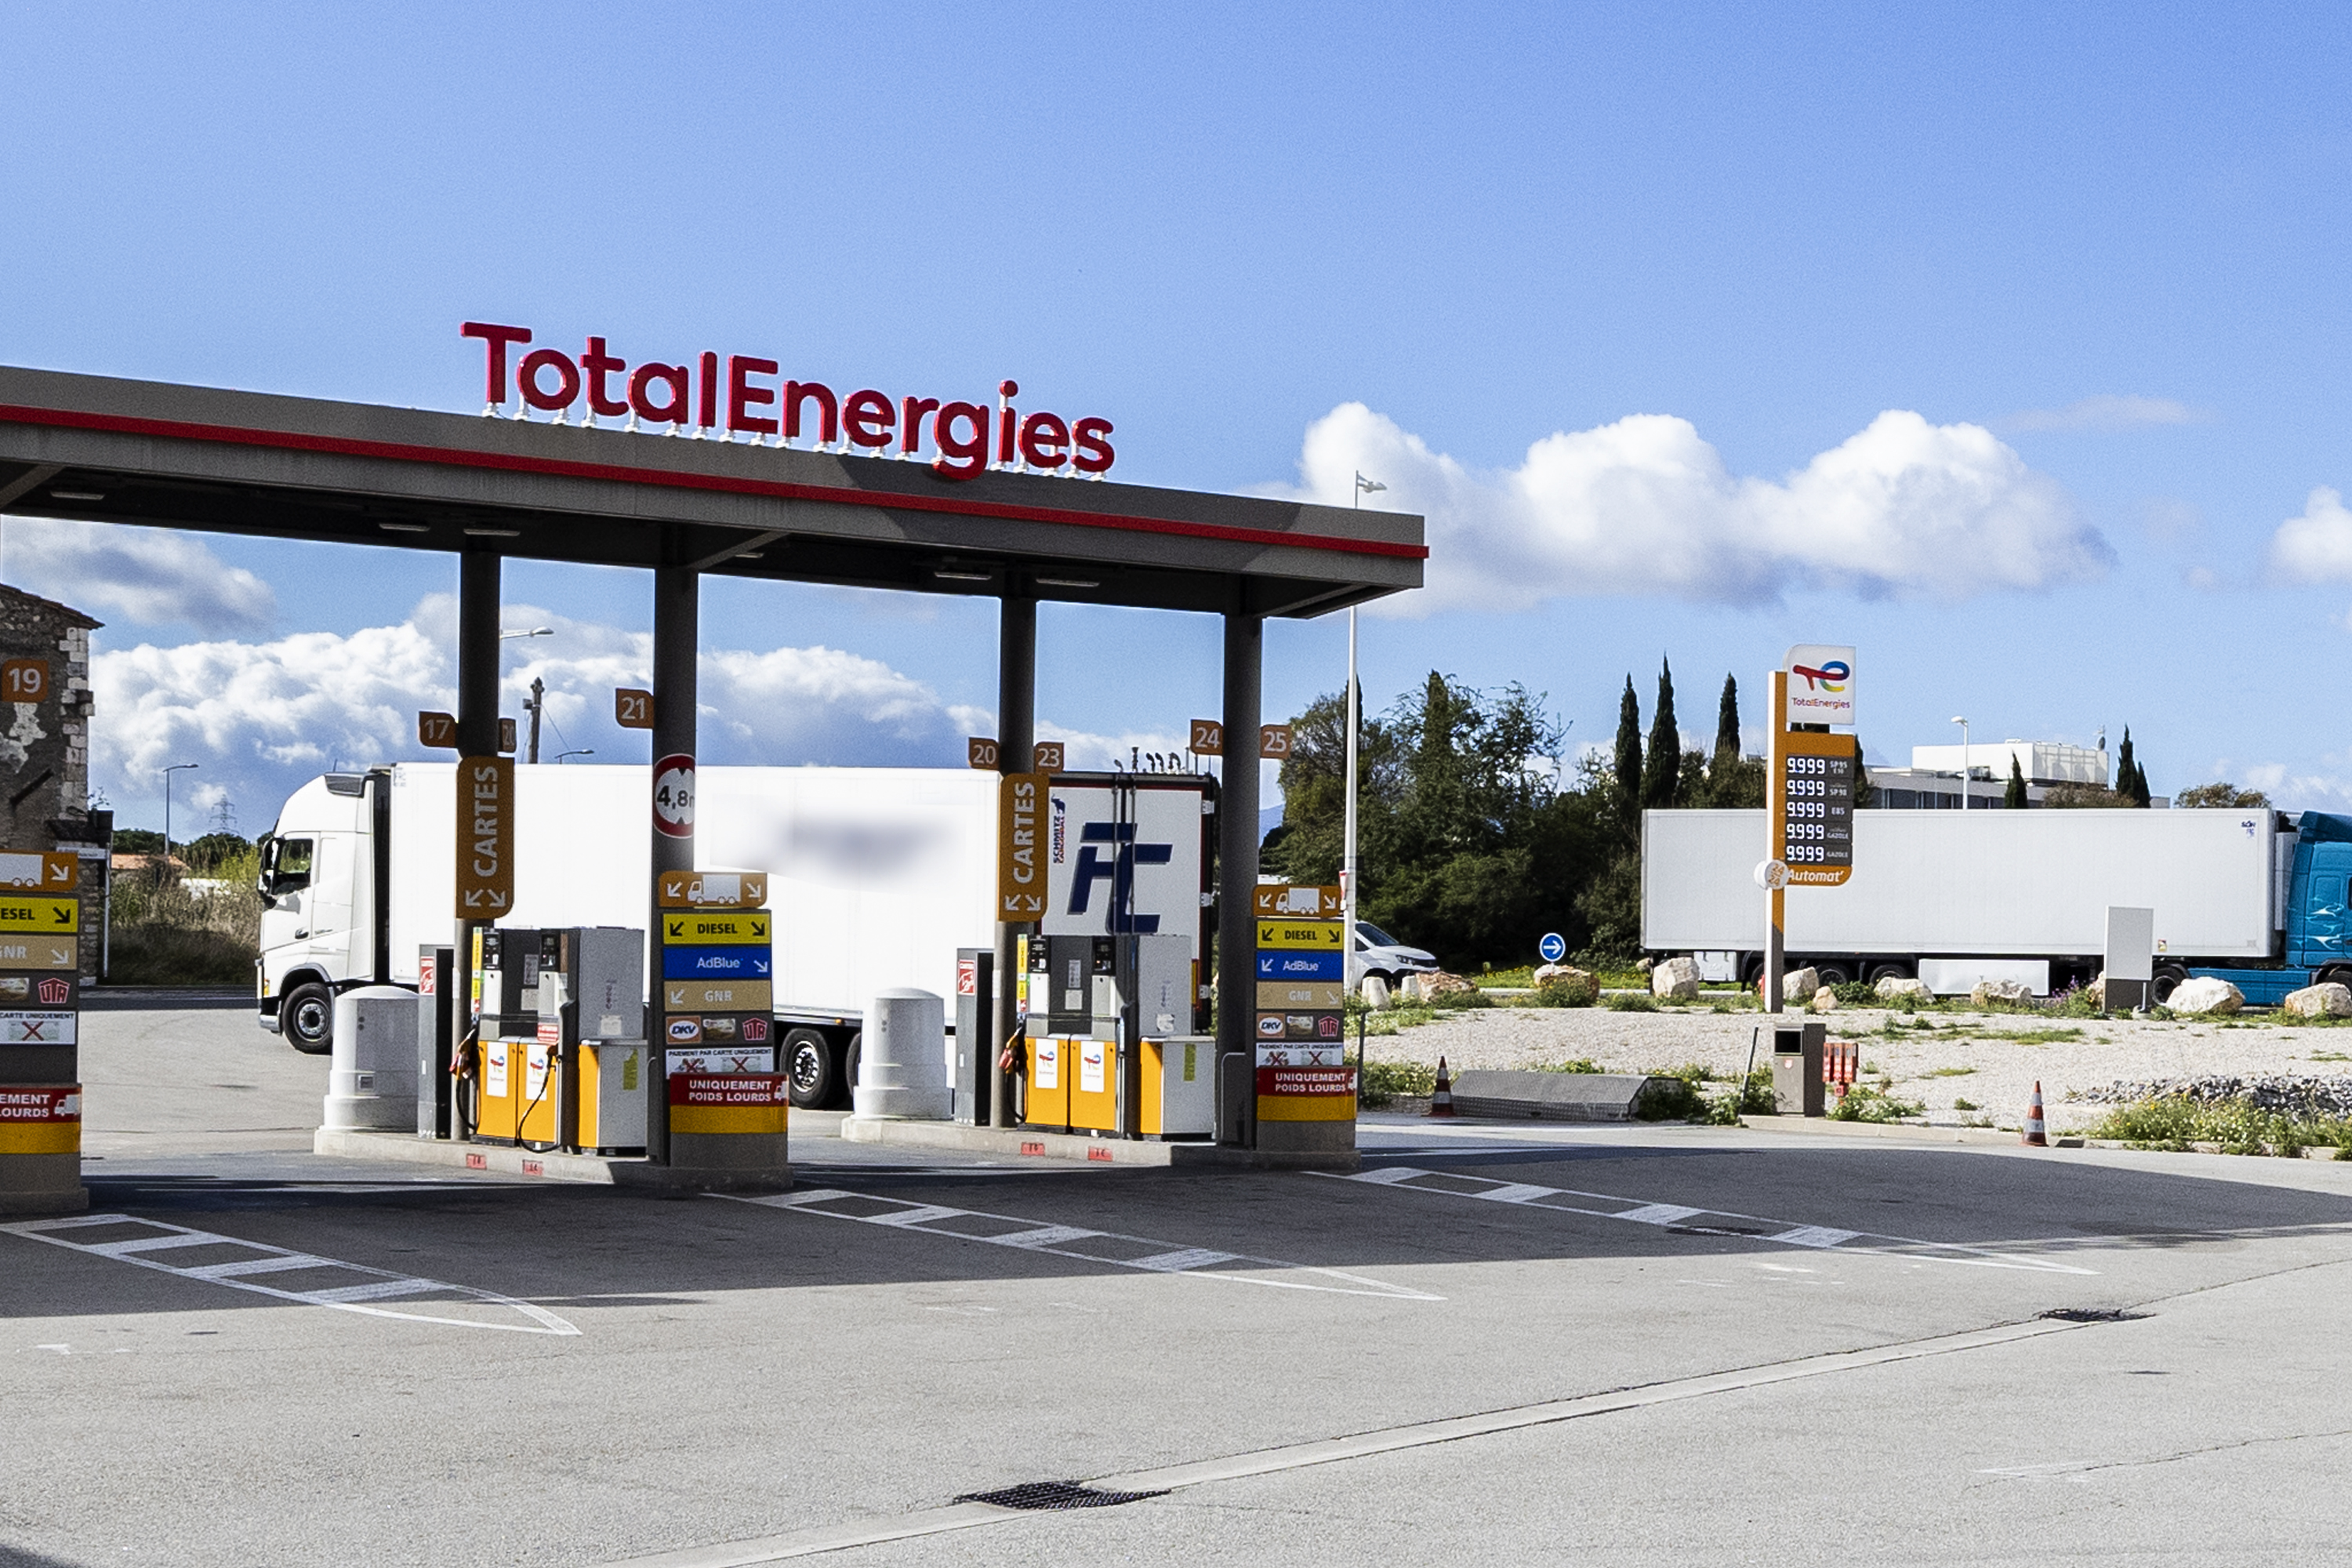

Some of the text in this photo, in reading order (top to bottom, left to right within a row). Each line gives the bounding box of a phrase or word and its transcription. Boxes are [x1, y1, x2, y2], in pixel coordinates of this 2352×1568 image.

[460, 321, 1115, 481] TotalEnergies
[9, 667, 42, 695] 19
[621, 696, 646, 720] 21
[1791, 697, 1851, 710] TotalEnergies
[424, 718, 451, 740] 17
[1196, 726, 1221, 749] 24
[1264, 730, 1287, 753] 25
[973, 744, 996, 764] 20
[1038, 747, 1061, 768] 23
[473, 765, 499, 877] CARTES
[1013, 782, 1036, 884] CARTES
[697, 923, 738, 935] DIESEL
[1284, 930, 1318, 941] DIESEL
[0, 946, 27, 959] NR
[704, 990, 733, 1002] GNR
[1288, 989, 1312, 1001] GNR
[671, 1025, 697, 1035] DKV
[1261, 1022, 1282, 1030] DKV
[1275, 1072, 1347, 1082] UNIQUEMENT
[689, 1080, 772, 1091] UNIQUEMENT
[1275, 1083, 1346, 1092] POIDS LOURDS
[688, 1092, 771, 1102] POIDS LOURDS
[0, 1107, 50, 1118] OURDS
